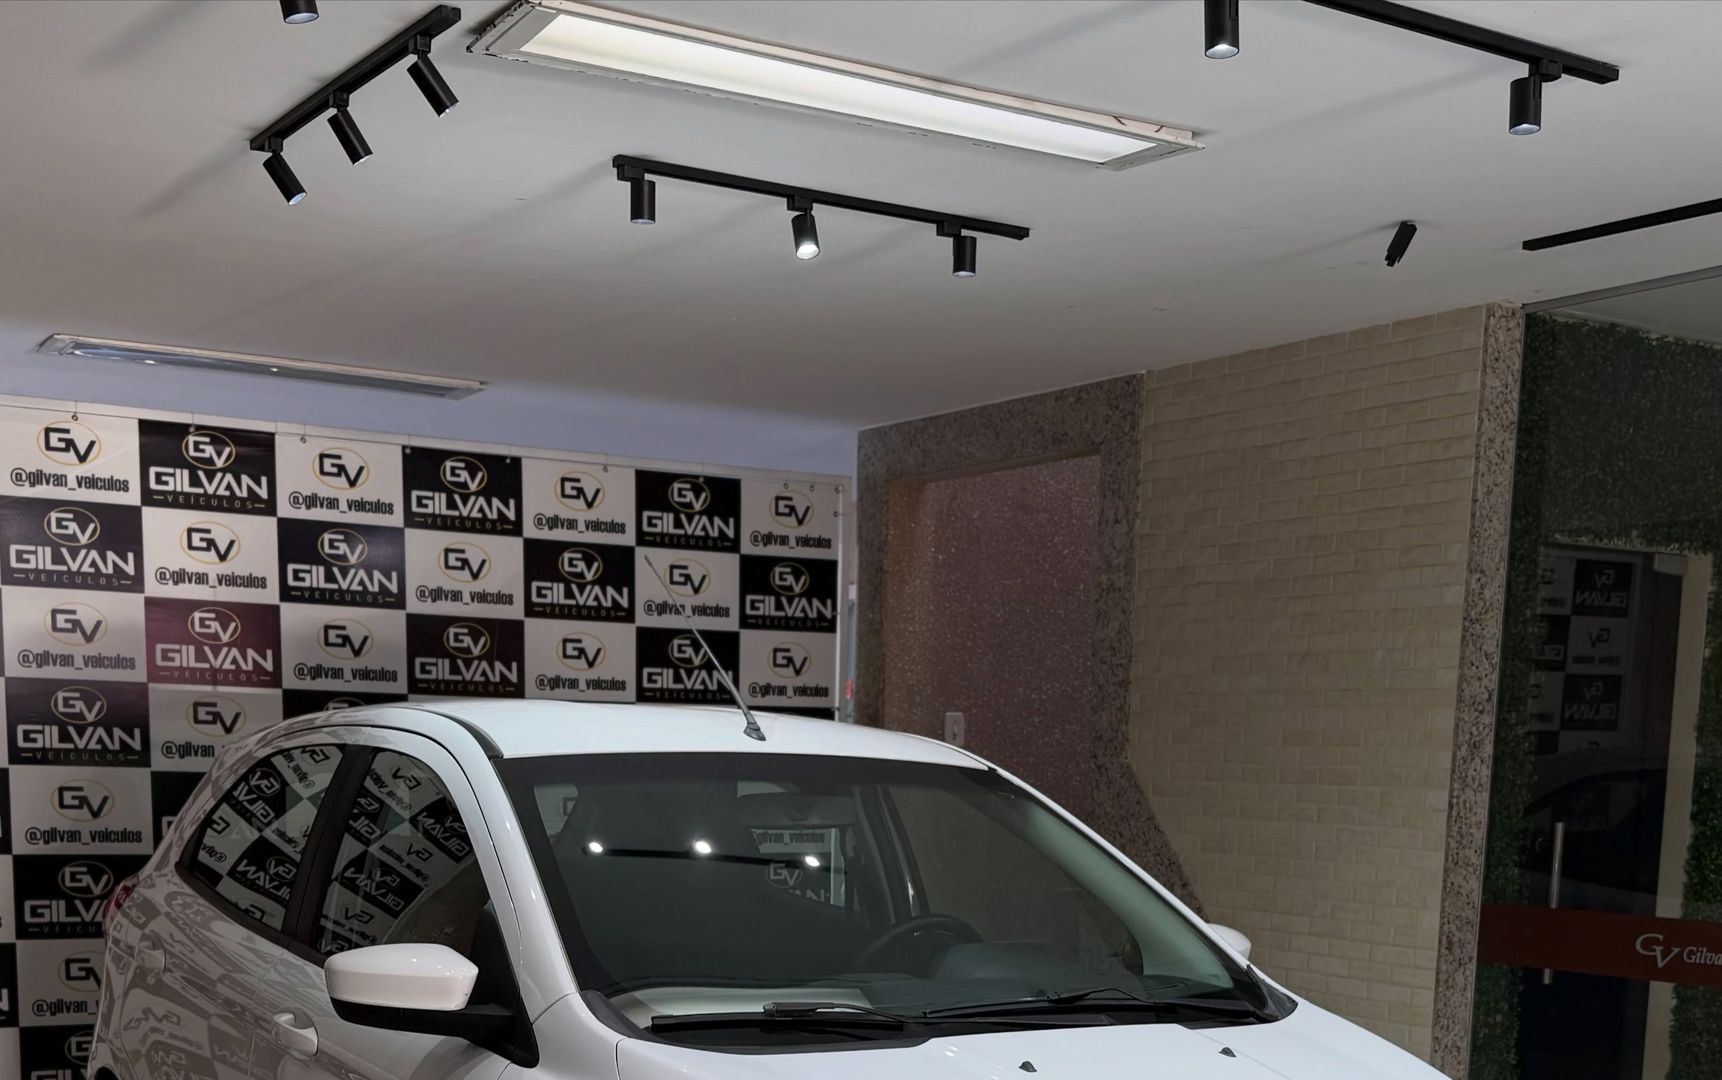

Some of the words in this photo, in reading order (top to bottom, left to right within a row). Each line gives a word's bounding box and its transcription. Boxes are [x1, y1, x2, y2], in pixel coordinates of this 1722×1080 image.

[44, 426, 97, 464] GV
[187, 435, 231, 467] GV
[10, 467, 130, 493] @gilvan_veiculos
[149, 466, 268, 499] GILVAN
[318, 452, 365, 489] GV
[445, 461, 483, 492] GV
[288, 491, 394, 516] @gilvan_veiculos
[411, 490, 516, 521] GILVAN
[560, 476, 601, 510] GV
[672, 482, 707, 512] GV
[533, 513, 626, 535] @gilvan_veiculos
[642, 510, 735, 539] GILVAN
[774, 495, 811, 527] GV
[50, 512, 95, 545] GV
[750, 530, 832, 550] @gilvan_veiculos
[187, 527, 236, 563] GV
[323, 533, 364, 564] GV
[9, 544, 135, 577] GILVAN
[443, 547, 488, 581] GV
[563, 552, 600, 581] GV
[155, 566, 267, 590] @gilvan_veiculos
[286, 563, 399, 594] GILVAN
[669, 564, 707, 596] GV
[774, 566, 807, 594] GV
[415, 585, 514, 606] @gilvan_veiculos
[531, 581, 629, 609] GILVAN
[643, 599, 730, 618] @gilvan_veiculos
[745, 594, 832, 620] GILVAN
[50, 608, 103, 644] GV
[193, 612, 237, 643] GV
[323, 624, 369, 658] GV
[448, 628, 486, 656] GV
[562, 638, 602, 669] GV
[672, 639, 706, 666] GV
[17, 649, 136, 671] @gilvan_veiculos
[155, 643, 274, 673] GILVAN
[293, 662, 398, 682] @gilvan_veiculos
[414, 657, 518, 684] GILVAN
[772, 648, 808, 677] GV
[535, 674, 626, 692] @gilvan_veiculos
[642, 667, 733, 691] GILVAN
[749, 682, 829, 698] @gilvan_veiculos
[57, 692, 102, 722] GV
[192, 701, 242, 734] GV
[17, 724, 142, 751] GILVAN
[161, 741, 215, 759] @gilvan
[58, 786, 110, 819] GV
[25, 827, 142, 845] @gilvan_veiculos
[64, 866, 109, 895] GV
[24, 900, 104, 923] GILV
[1635, 933, 1680, 968] GV
[32, 998, 98, 1017] @gilvan_
